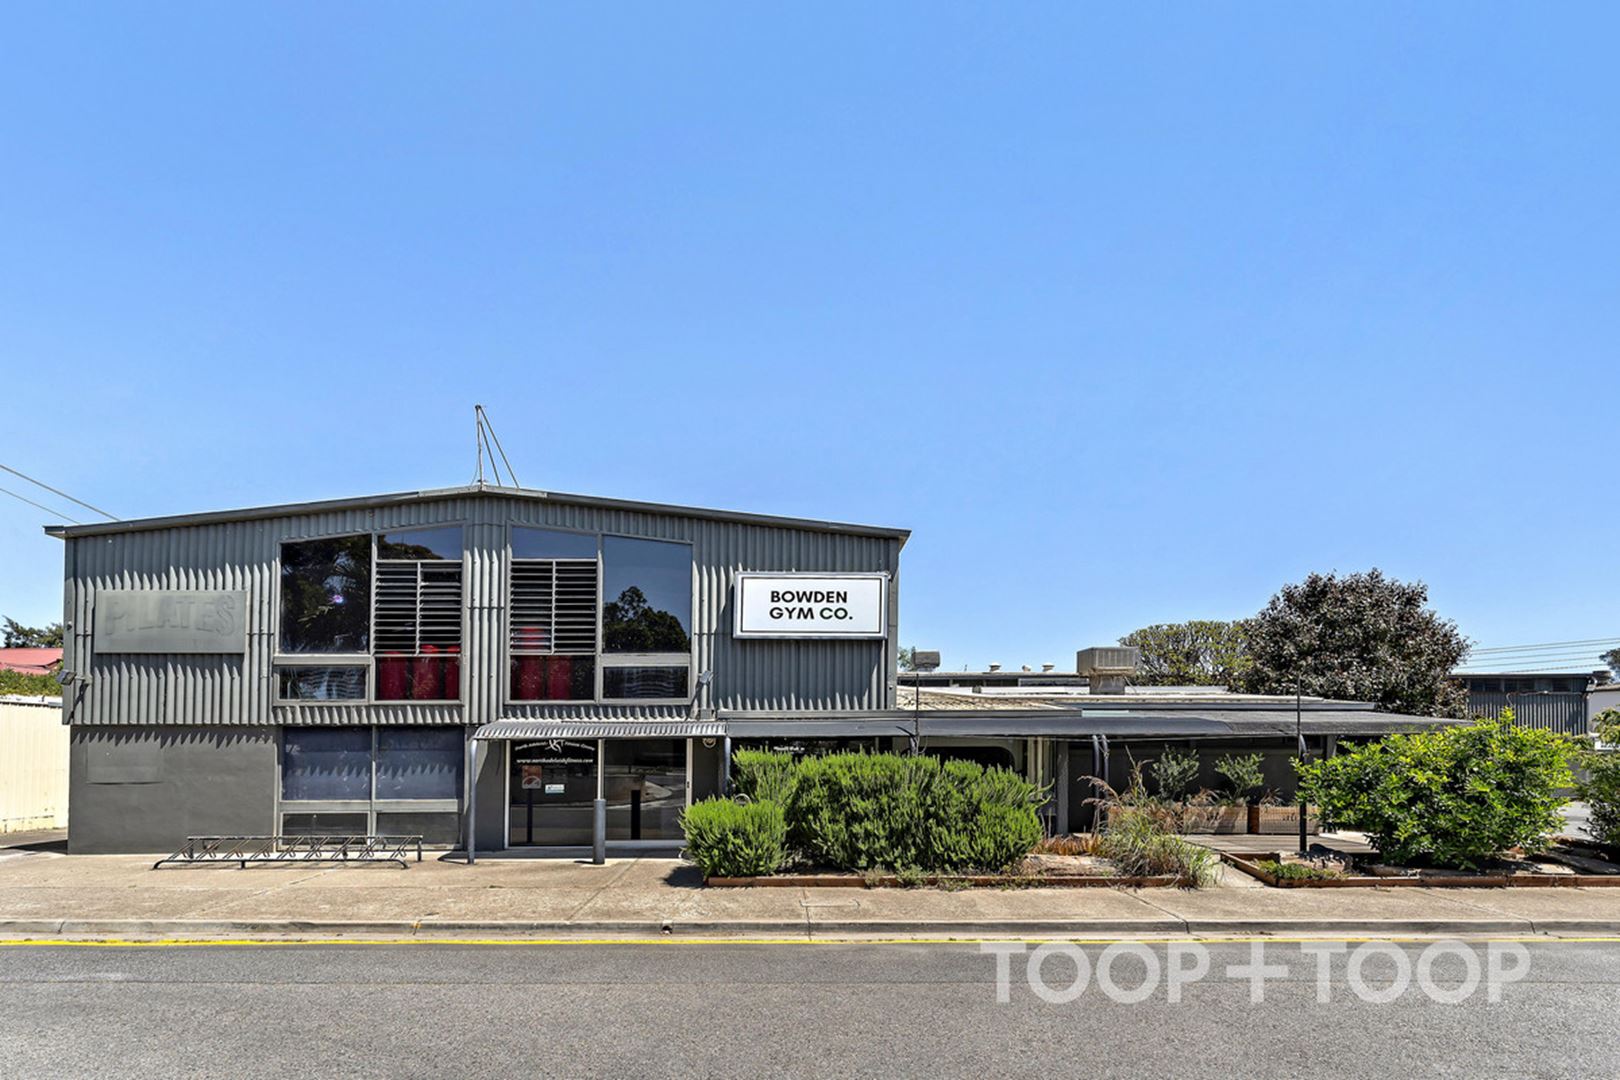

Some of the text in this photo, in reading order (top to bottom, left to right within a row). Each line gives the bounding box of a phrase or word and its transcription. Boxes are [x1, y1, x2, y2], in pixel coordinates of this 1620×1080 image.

[770, 590, 848, 604] BOWDEN
[769, 607, 854, 620] GYM CO.
